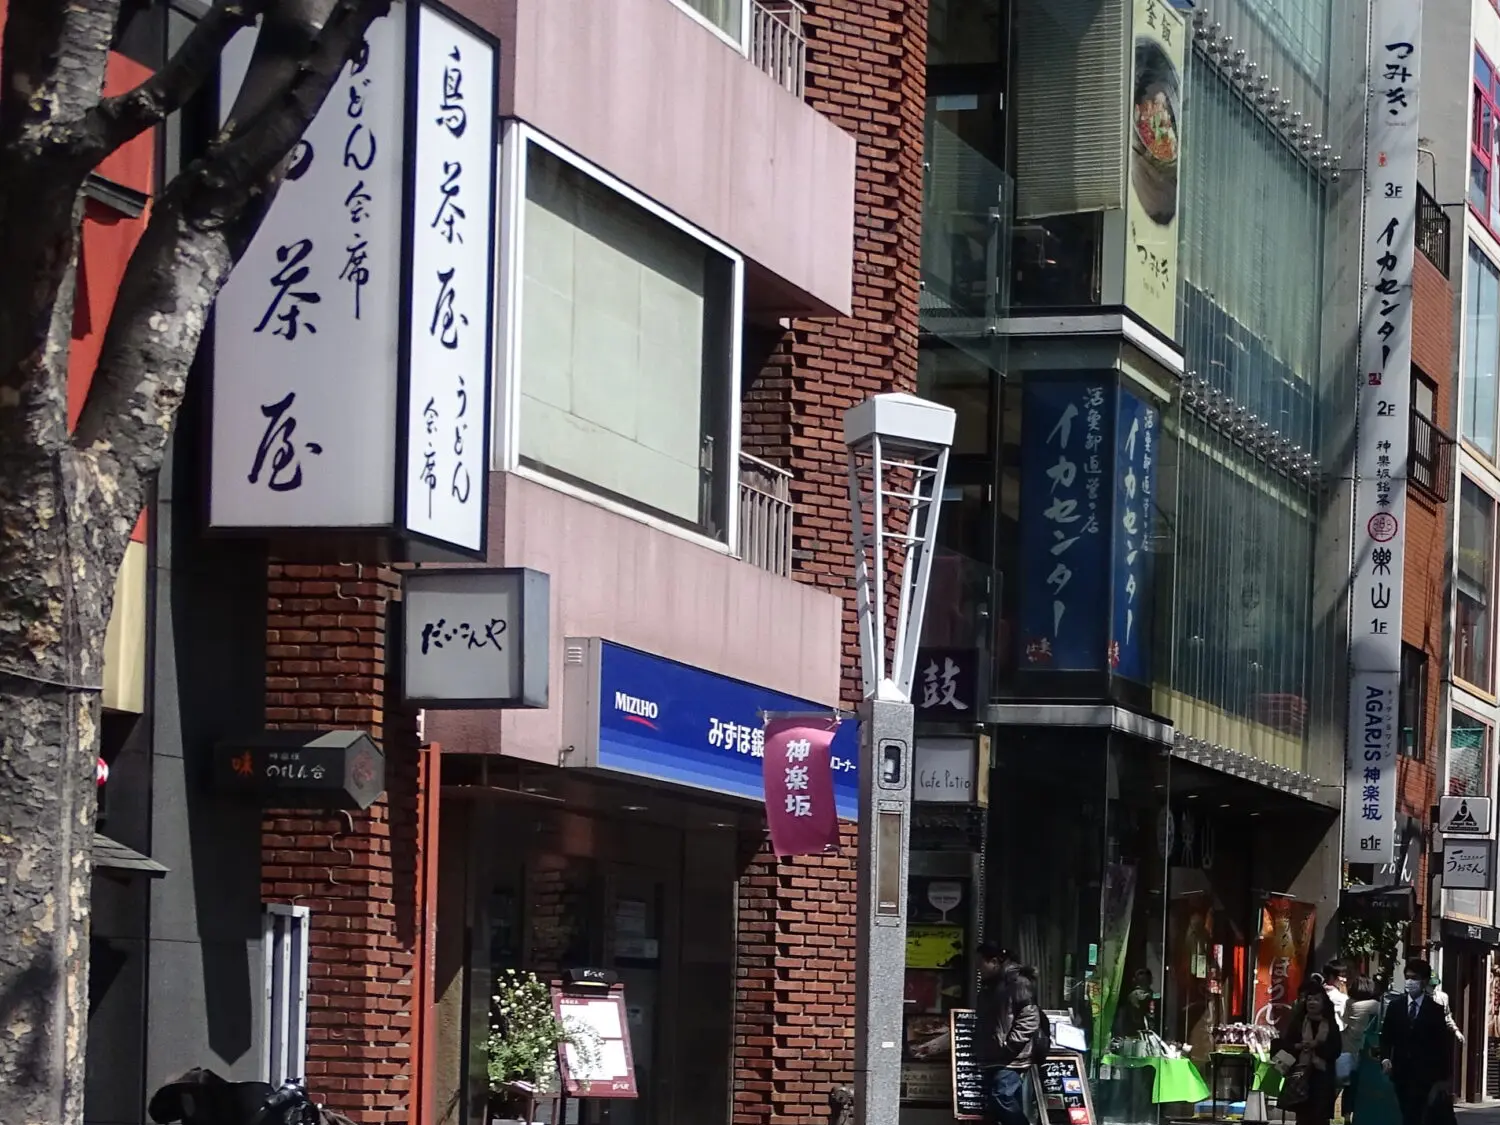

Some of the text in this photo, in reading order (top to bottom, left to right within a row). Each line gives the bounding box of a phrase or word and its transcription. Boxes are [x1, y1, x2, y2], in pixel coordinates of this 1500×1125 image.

[1385, 182, 1403, 198] 3F
[249, 139, 322, 491] 茶屋
[1374, 217, 1401, 369] イカセンター
[453, 375, 470, 504] うどん
[1377, 400, 1396, 416] 2F
[1043, 402, 1082, 638] イカセンター
[1123, 417, 1140, 645] イカセンター
[1371, 619, 1388, 634] 1F
[615, 691, 659, 719] MIZUHO
[921, 656, 969, 710] 鼓
[708, 718, 764, 758] みずほ銀
[1362, 686, 1384, 821] AGARIS 神楽坂
[785, 739, 813, 817] 神楽坂
[1360, 835, 1381, 850] B1F
